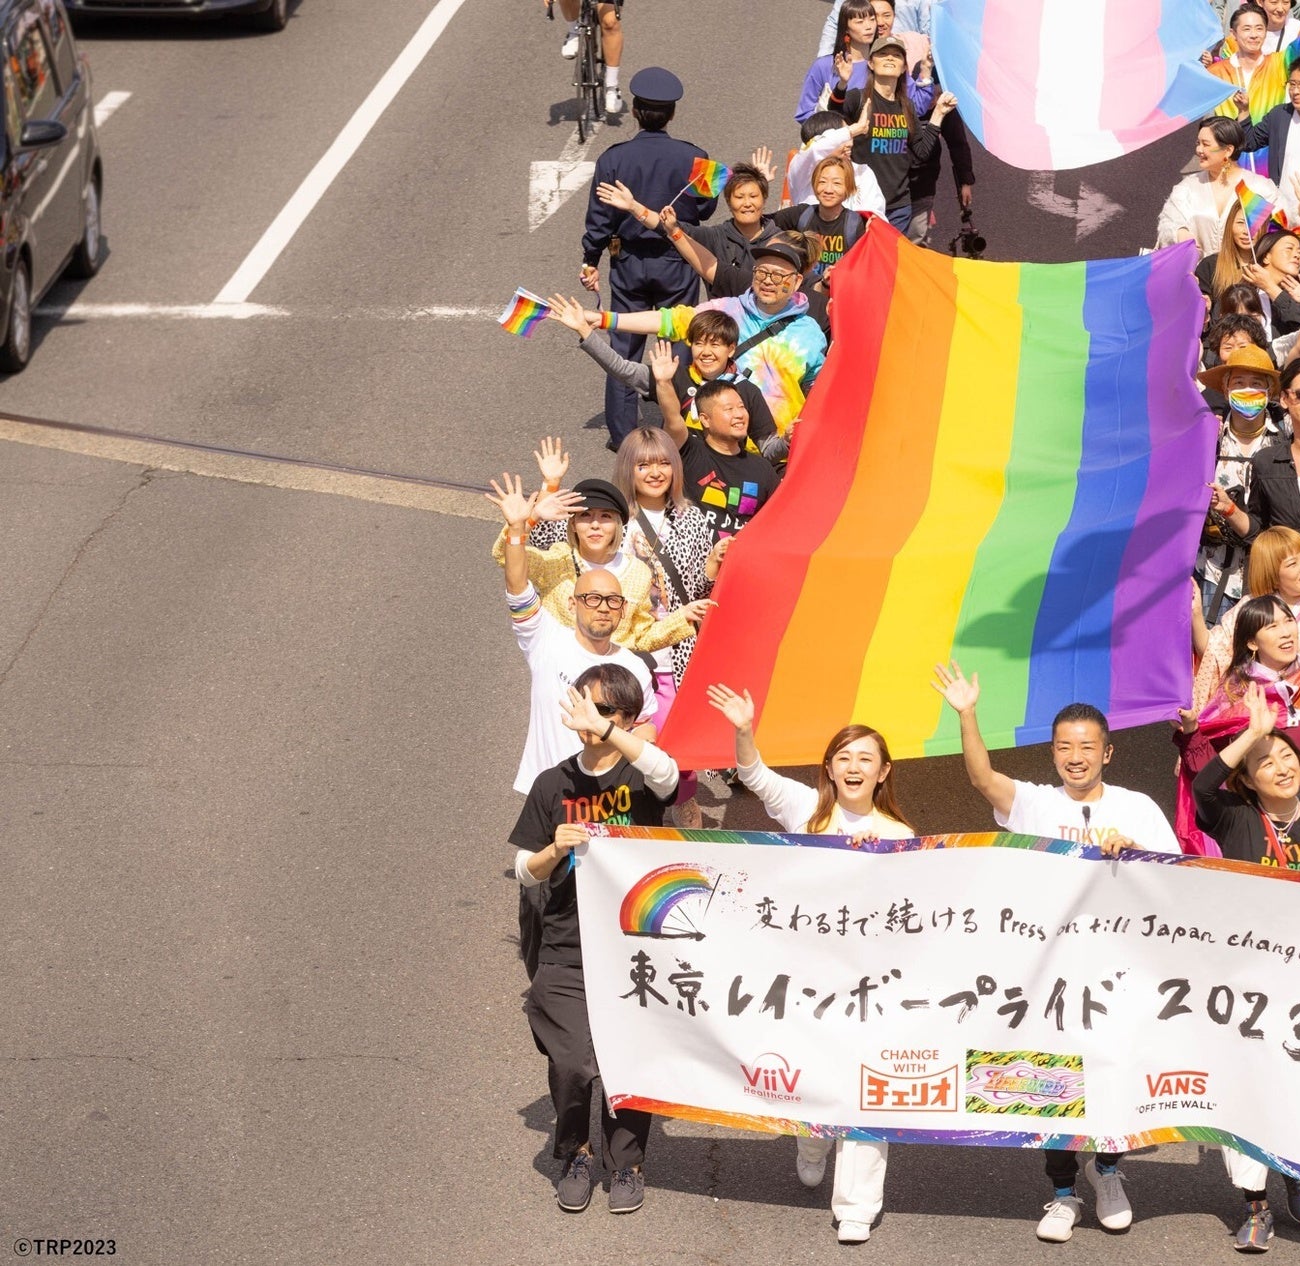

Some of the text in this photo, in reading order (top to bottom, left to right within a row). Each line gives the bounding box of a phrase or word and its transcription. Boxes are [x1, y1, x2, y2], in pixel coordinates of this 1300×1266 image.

[873, 113, 908, 128] TOKYO
[872, 127, 909, 138] RAINBOW
[871, 138, 908, 154] PRIDE
[815, 233, 844, 252] KYO
[562, 784, 631, 824] TOKYO
[1000, 907, 1046, 942] Press
[1056, 920, 1078, 937] on
[1089, 916, 1131, 934] till
[1141, 914, 1216, 944] Japan
[620, 948, 1126, 1032] 東京レインボープライド
[880, 1049, 940, 1061] CHANGE
[893, 1063, 927, 1073] WITH
[740, 1063, 801, 1094] ViiV
[1146, 1070, 1209, 1098] VANS
[743, 1085, 802, 1103] Healthcare
[867, 1075, 951, 1106] チェリオ
[1159, 1101, 1178, 1110] THE
